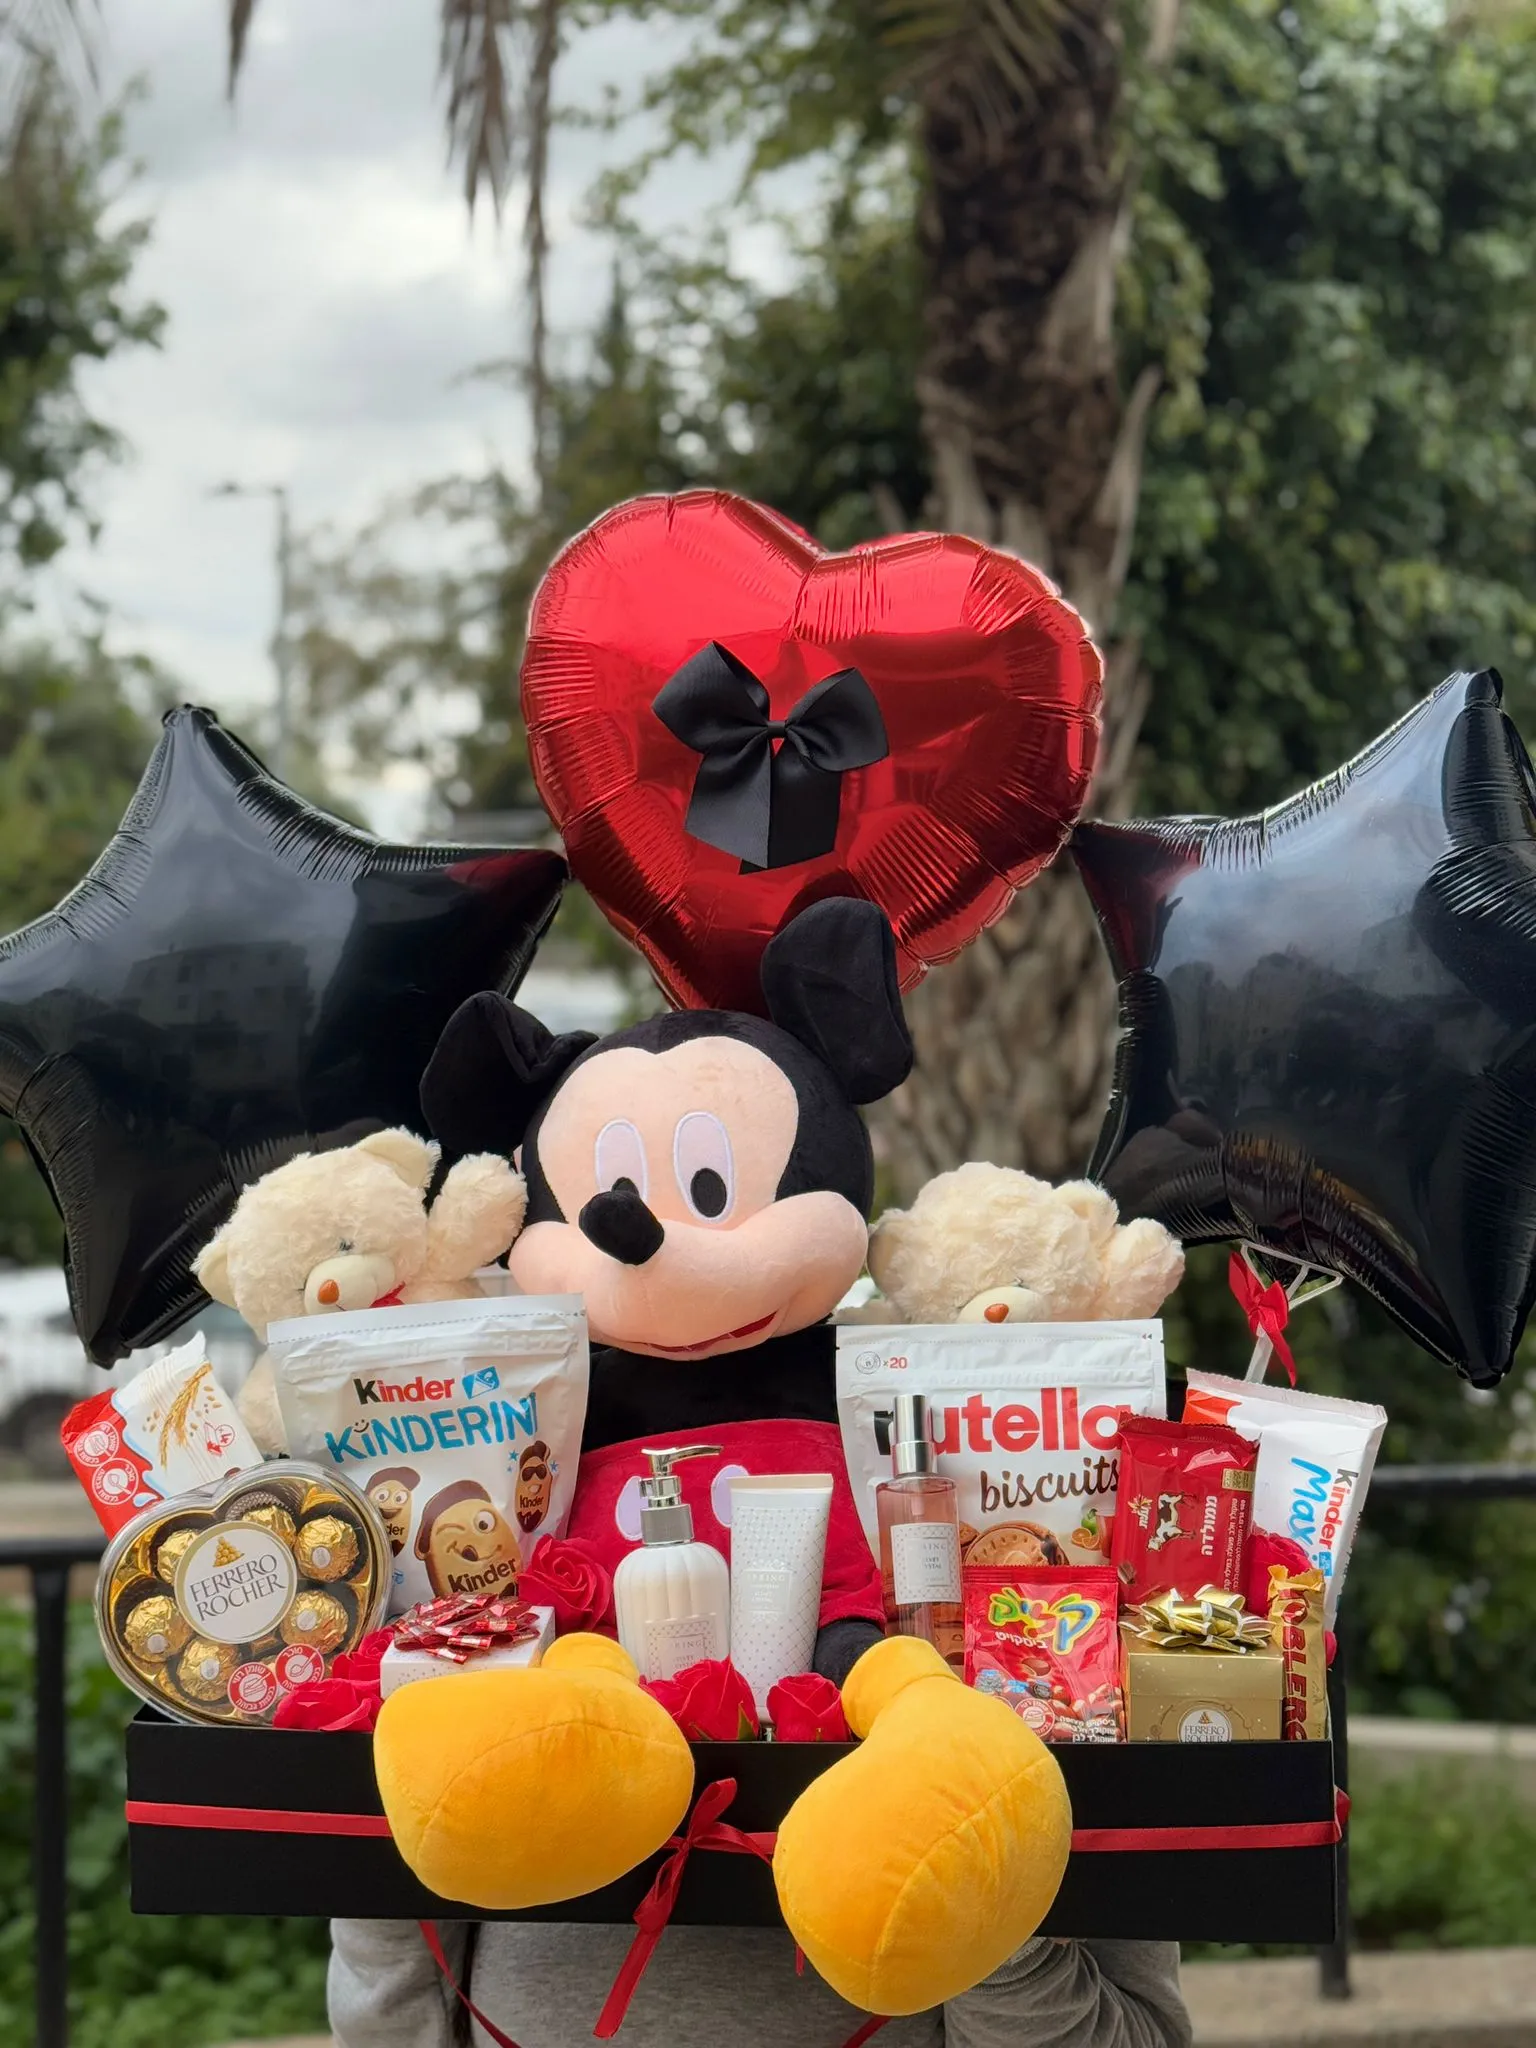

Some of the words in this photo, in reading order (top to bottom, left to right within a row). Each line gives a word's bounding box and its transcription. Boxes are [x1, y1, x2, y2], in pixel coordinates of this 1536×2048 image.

[353, 1376, 455, 1405] Kinder
[980, 1456, 1118, 1513] biscuits
[519, 1494, 544, 1509] Kinder
[1318, 1468, 1360, 1550] Kinder
[190, 1554, 279, 1602] FERRERO
[448, 1558, 518, 1594] Kinder
[196, 1573, 287, 1621] ROCHER
[282, 1646, 303, 1658] סוכר
[245, 1664, 266, 1676] שומן
[1184, 1726, 1226, 1735] FERRERO
